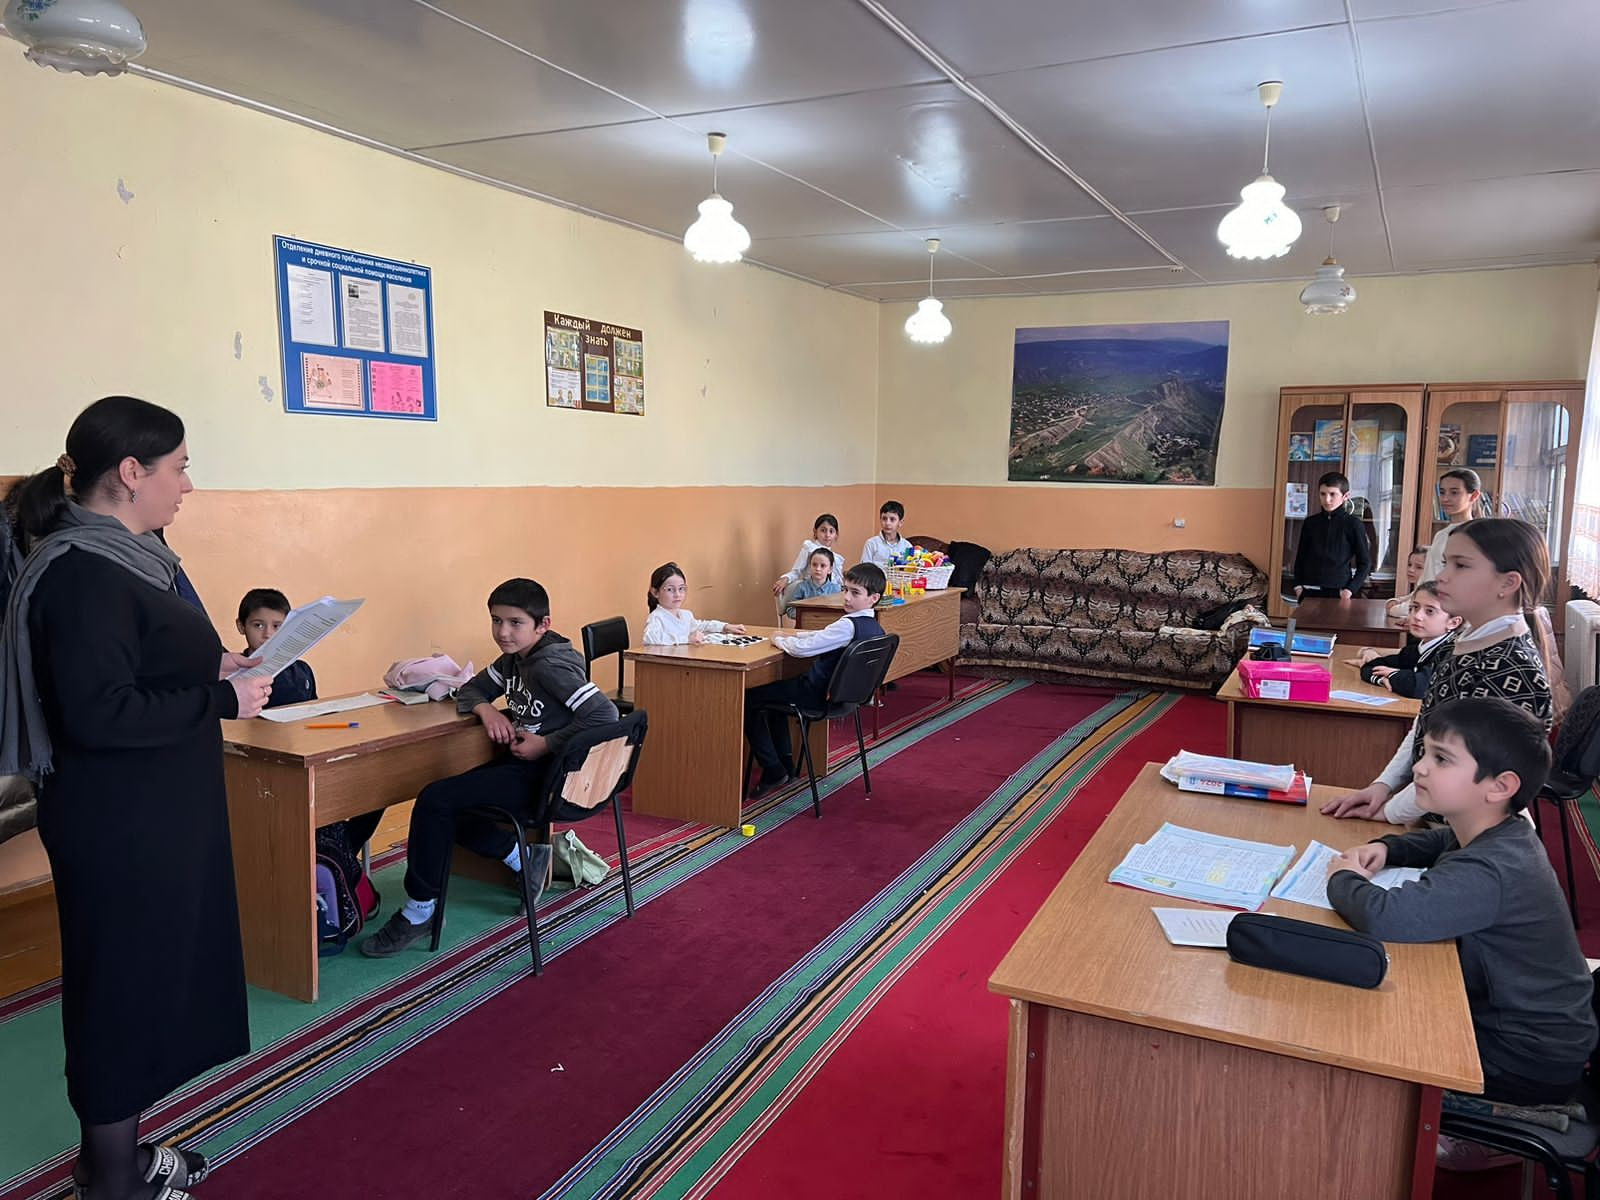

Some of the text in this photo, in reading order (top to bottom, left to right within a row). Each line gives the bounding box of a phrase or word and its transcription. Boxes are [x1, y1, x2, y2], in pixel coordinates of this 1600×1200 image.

[281, 240, 314, 254] Отделение
[315, 248, 341, 260] дневного
[342, 254, 374, 266] пребывания
[307, 257, 330, 267] срочной
[331, 263, 364, 274] социальной
[365, 268, 385, 279] помощи
[386, 273, 412, 283] населения
[553, 313, 632, 339] Каждый должен
[585, 334, 609, 347] знать
